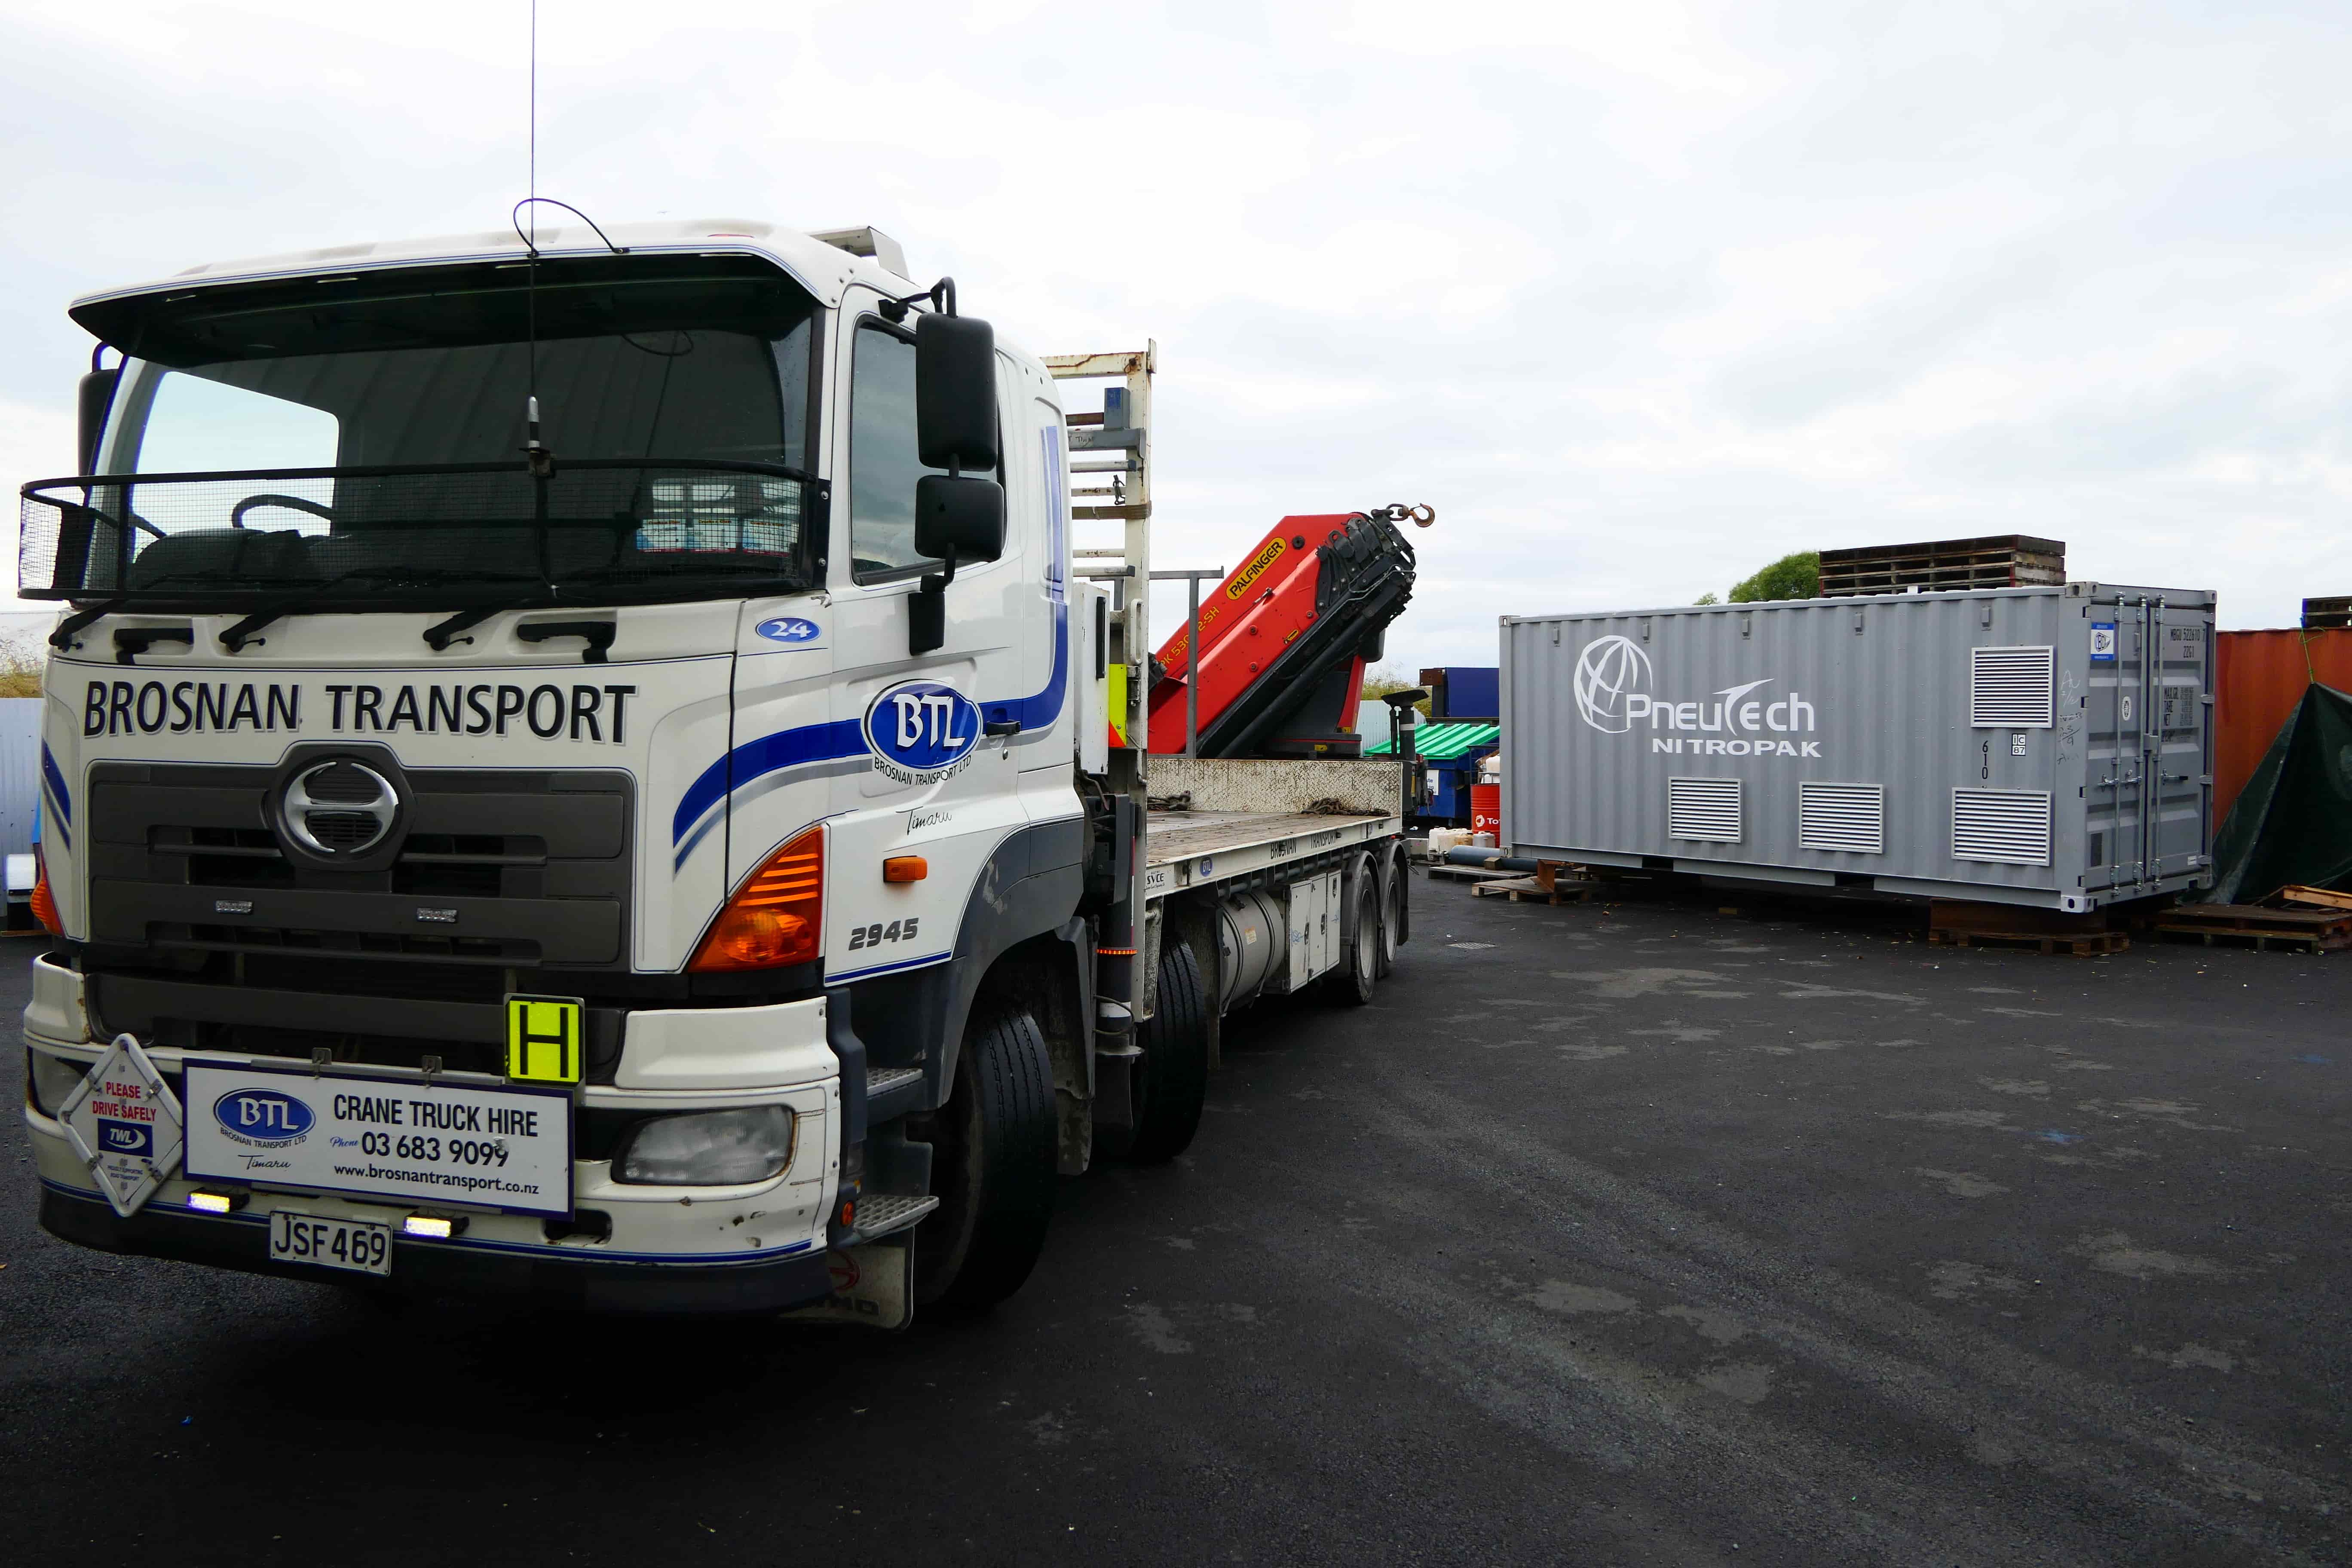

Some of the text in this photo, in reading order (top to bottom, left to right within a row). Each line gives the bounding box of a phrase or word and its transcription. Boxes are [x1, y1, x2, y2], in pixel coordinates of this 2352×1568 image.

[1229, 541, 1283, 597] PALFINGER
[771, 621, 812, 638] 24
[1171, 606, 1220, 656] 5302-SH
[2184, 628, 2200, 641] 522610
[2183, 646, 2194, 658] 22G1
[84, 681, 637, 744] BROSNAN TRANSPORT
[891, 693, 966, 747] BTL
[1652, 738, 1822, 758] NITROPAK
[874, 754, 971, 786] BROSNAN TRANSPORT LTD
[895, 806, 952, 836] Timaru
[1270, 830, 1337, 859] BROSNAN TRANSPORT
[1146, 873, 1164, 885] SVCE
[1203, 860, 1211, 873] BTL
[848, 917, 919, 951] 2945
[520, 1004, 569, 1078] H
[106, 1081, 141, 1099] PLEASE
[92, 1100, 157, 1121] DRIVE SAFELY
[237, 1097, 300, 1130] BTL
[334, 1093, 539, 1137] CRANE TRUCK HIRE
[110, 1128, 133, 1143] TWL
[220, 1127, 307, 1148] BROSNAN TRANSPORT LTD
[330, 1131, 509, 1167] Phone 03 683 9099
[237, 1154, 291, 1170] Timaru
[334, 1163, 539, 1194] www.brosnantransport.co.nz
[275, 1220, 386, 1266] JSF469
